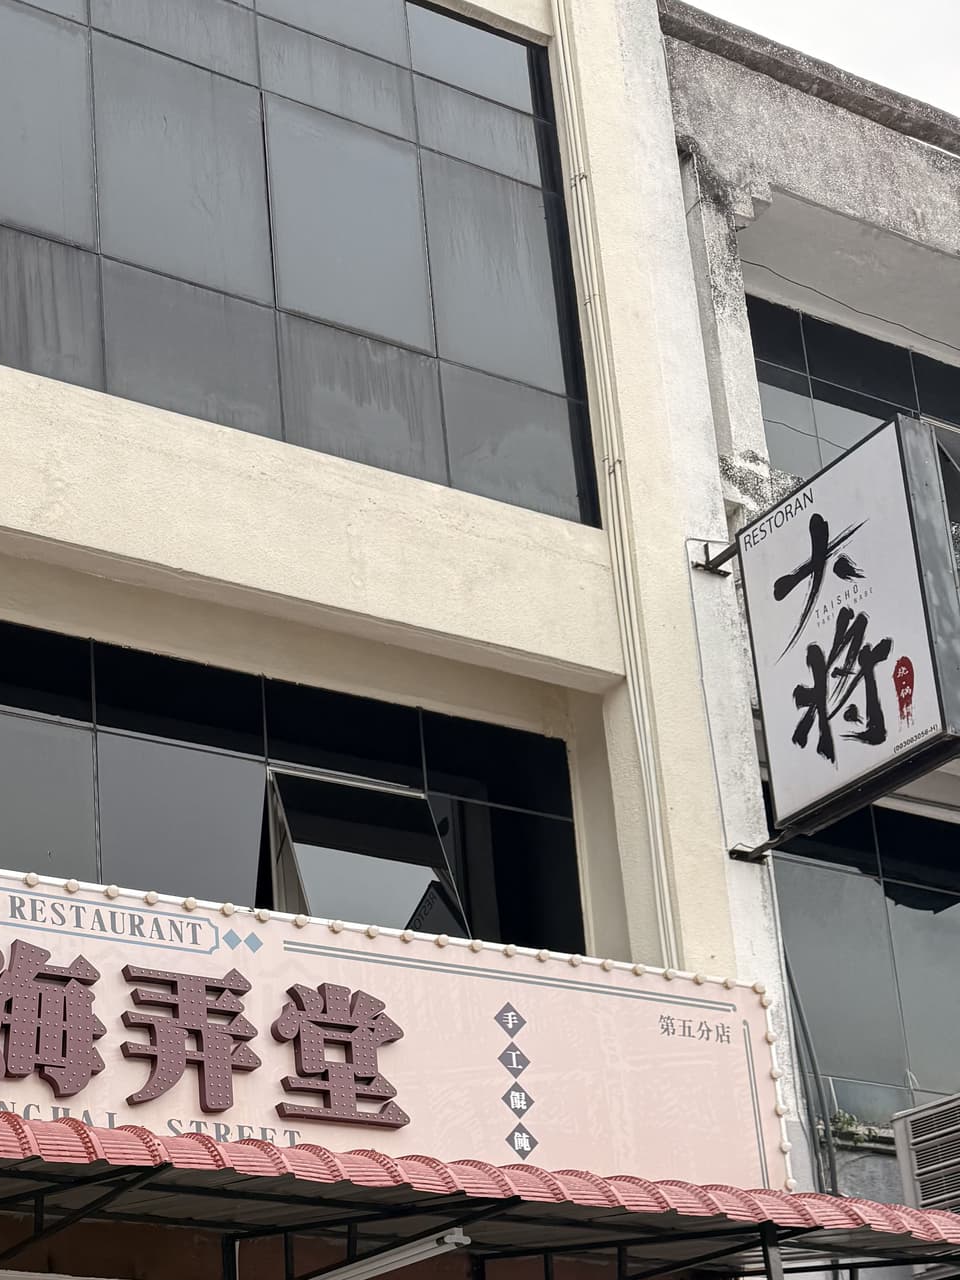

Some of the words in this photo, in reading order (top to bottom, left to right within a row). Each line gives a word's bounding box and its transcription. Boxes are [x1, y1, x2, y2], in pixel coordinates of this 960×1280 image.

[743, 487, 814, 552] RESTORAN
[7, 894, 203, 946] RESTAURANT
[658, 1014, 732, 1045] 第五分店
